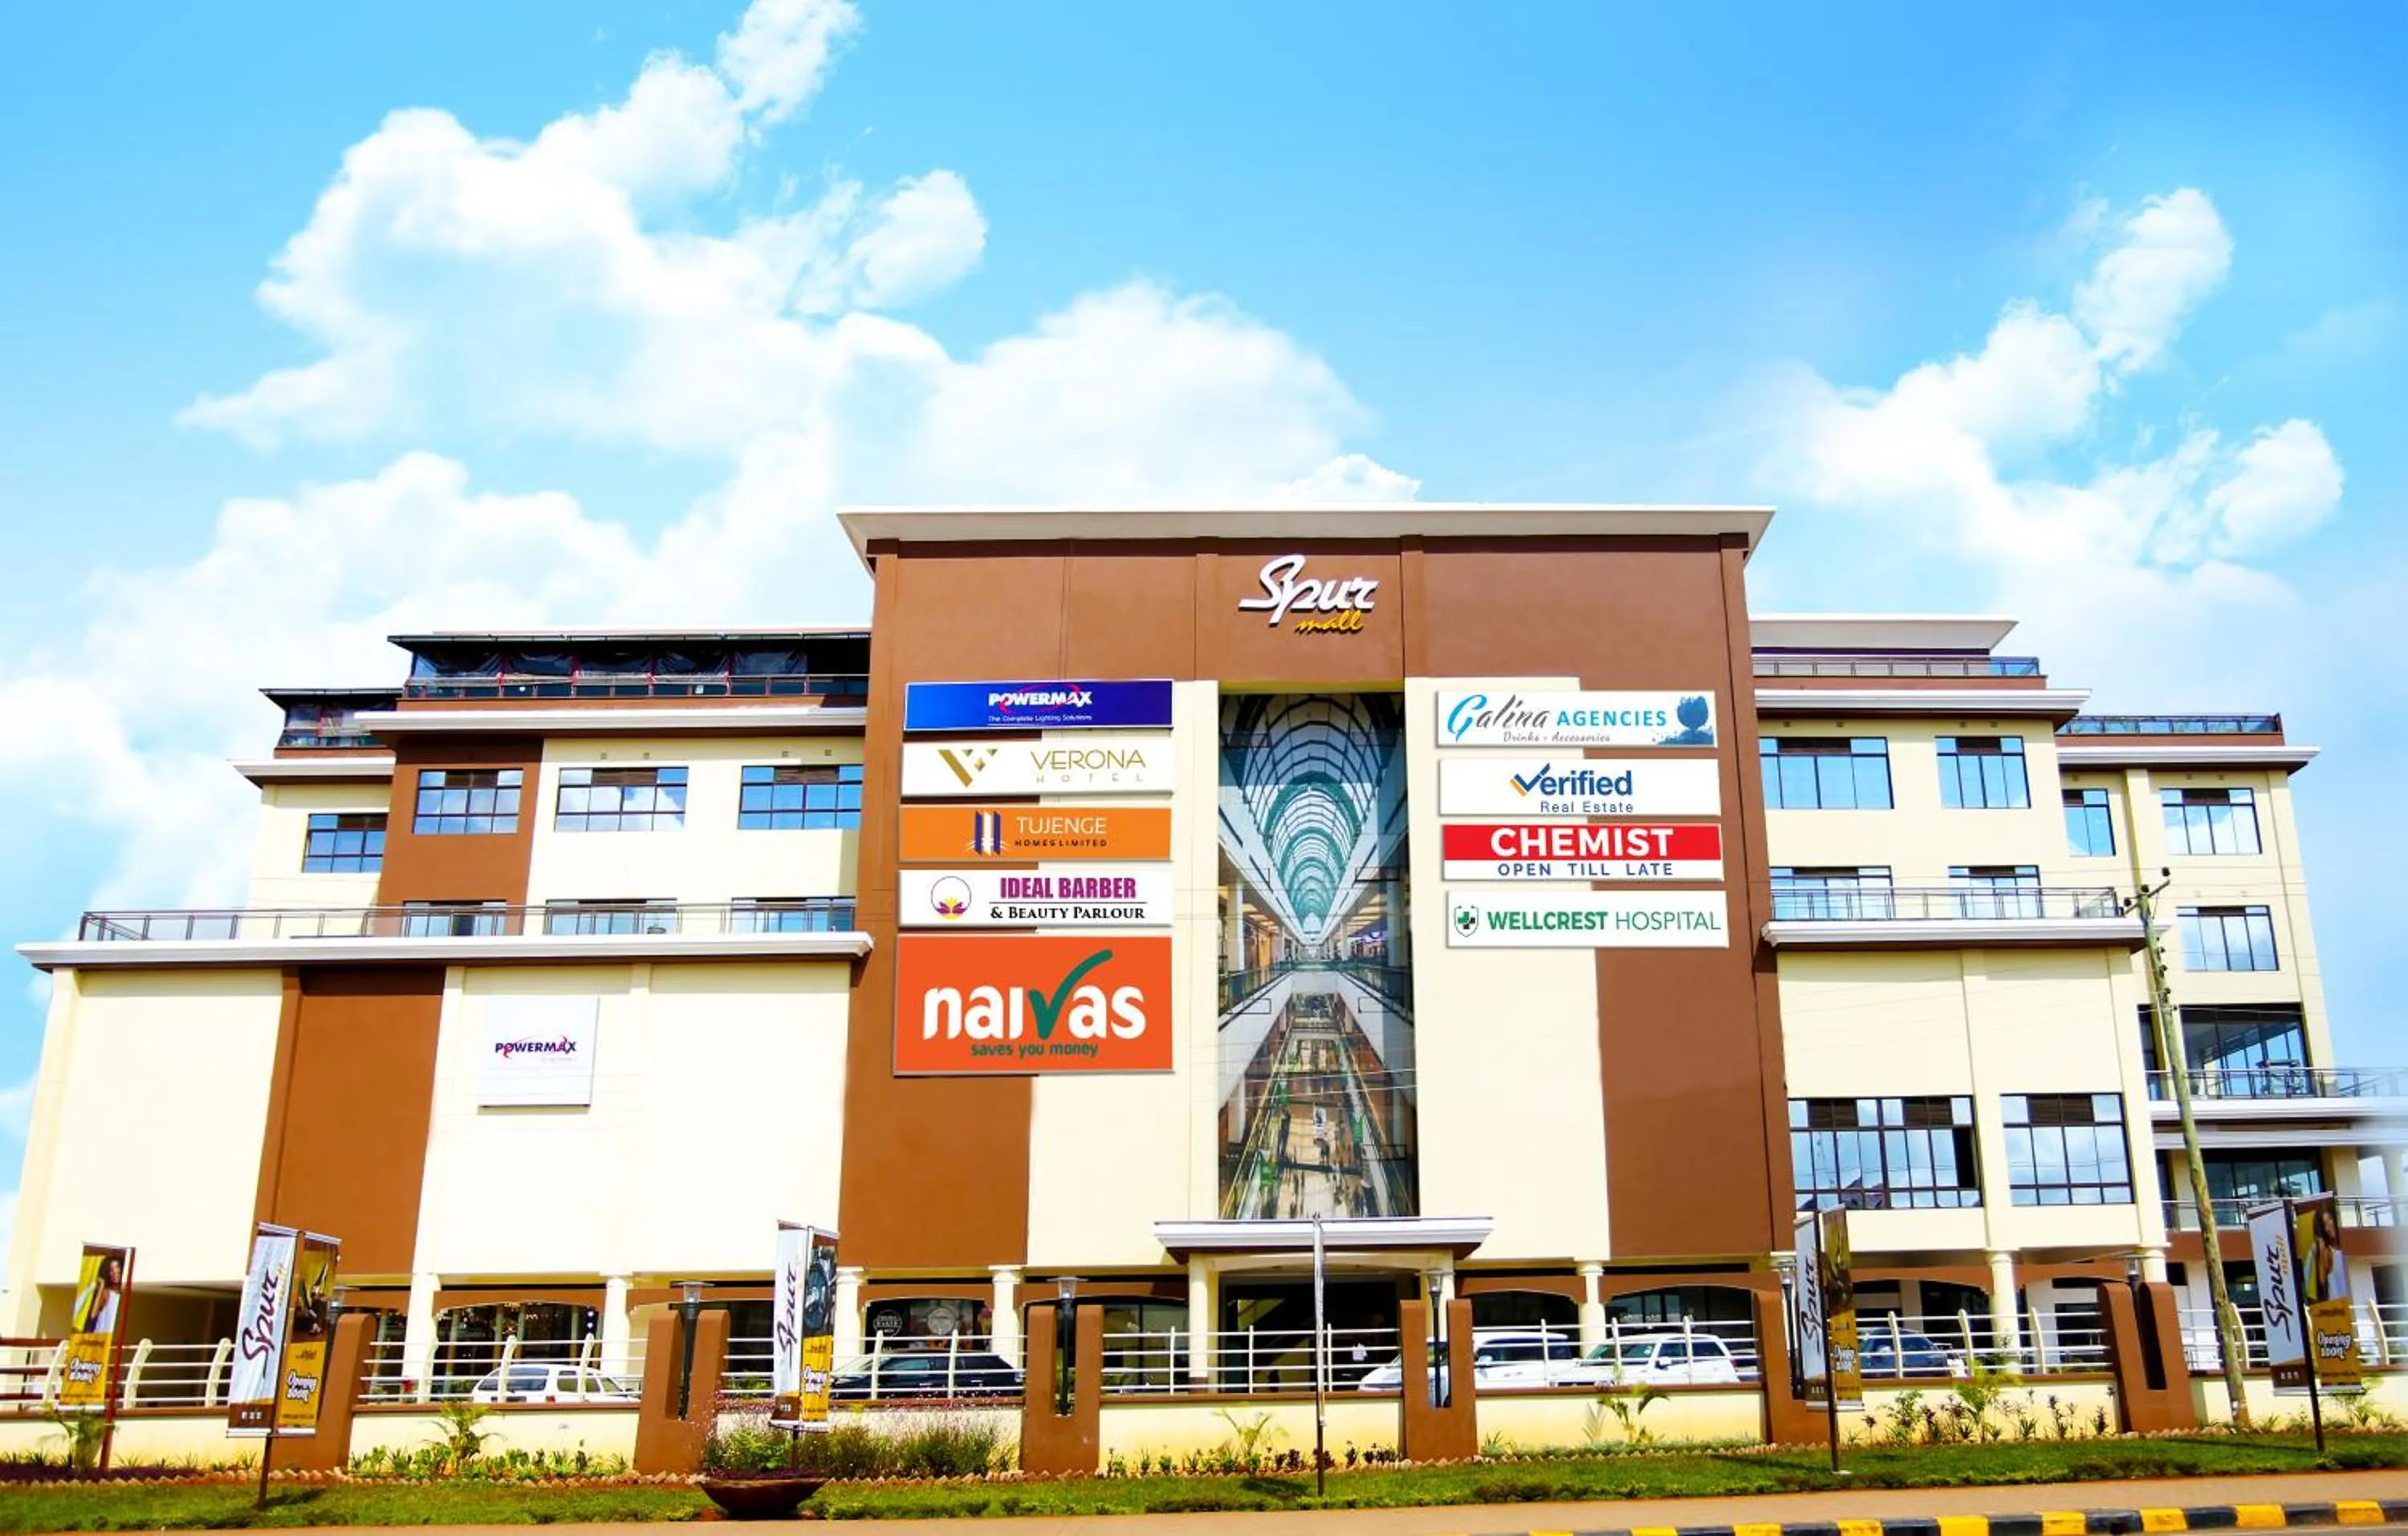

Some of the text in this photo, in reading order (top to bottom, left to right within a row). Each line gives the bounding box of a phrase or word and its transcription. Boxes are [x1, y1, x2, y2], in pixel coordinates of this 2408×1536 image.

[1238, 555, 1380, 624] Spur
[1296, 609, 1365, 633] mall
[988, 691, 1092, 707] POWERMAX
[1447, 694, 1667, 742] Galina AGENCIES
[1503, 731, 1610, 742] Drinks Accessories
[1030, 749, 1146, 770] VERONA
[1036, 773, 1143, 783] HOTEL
[1510, 763, 1633, 797] Verified
[1540, 801, 1633, 813] Real Estate
[1015, 816, 1107, 835] TUJENGE
[1491, 828, 1674, 856] CHEMIST
[1498, 863, 1674, 876] OPEN TILL LATE
[999, 877, 1137, 900] IDEAL BARBER
[990, 907, 1003, 920] &
[1487, 911, 1722, 930] WELLCREST HOSPITAL
[494, 1041, 577, 1054] POWERMAX
[970, 1043, 1099, 1059] saves you money
[2264, 1245, 2293, 1342] Spur
[242, 1268, 279, 1380] Spur
